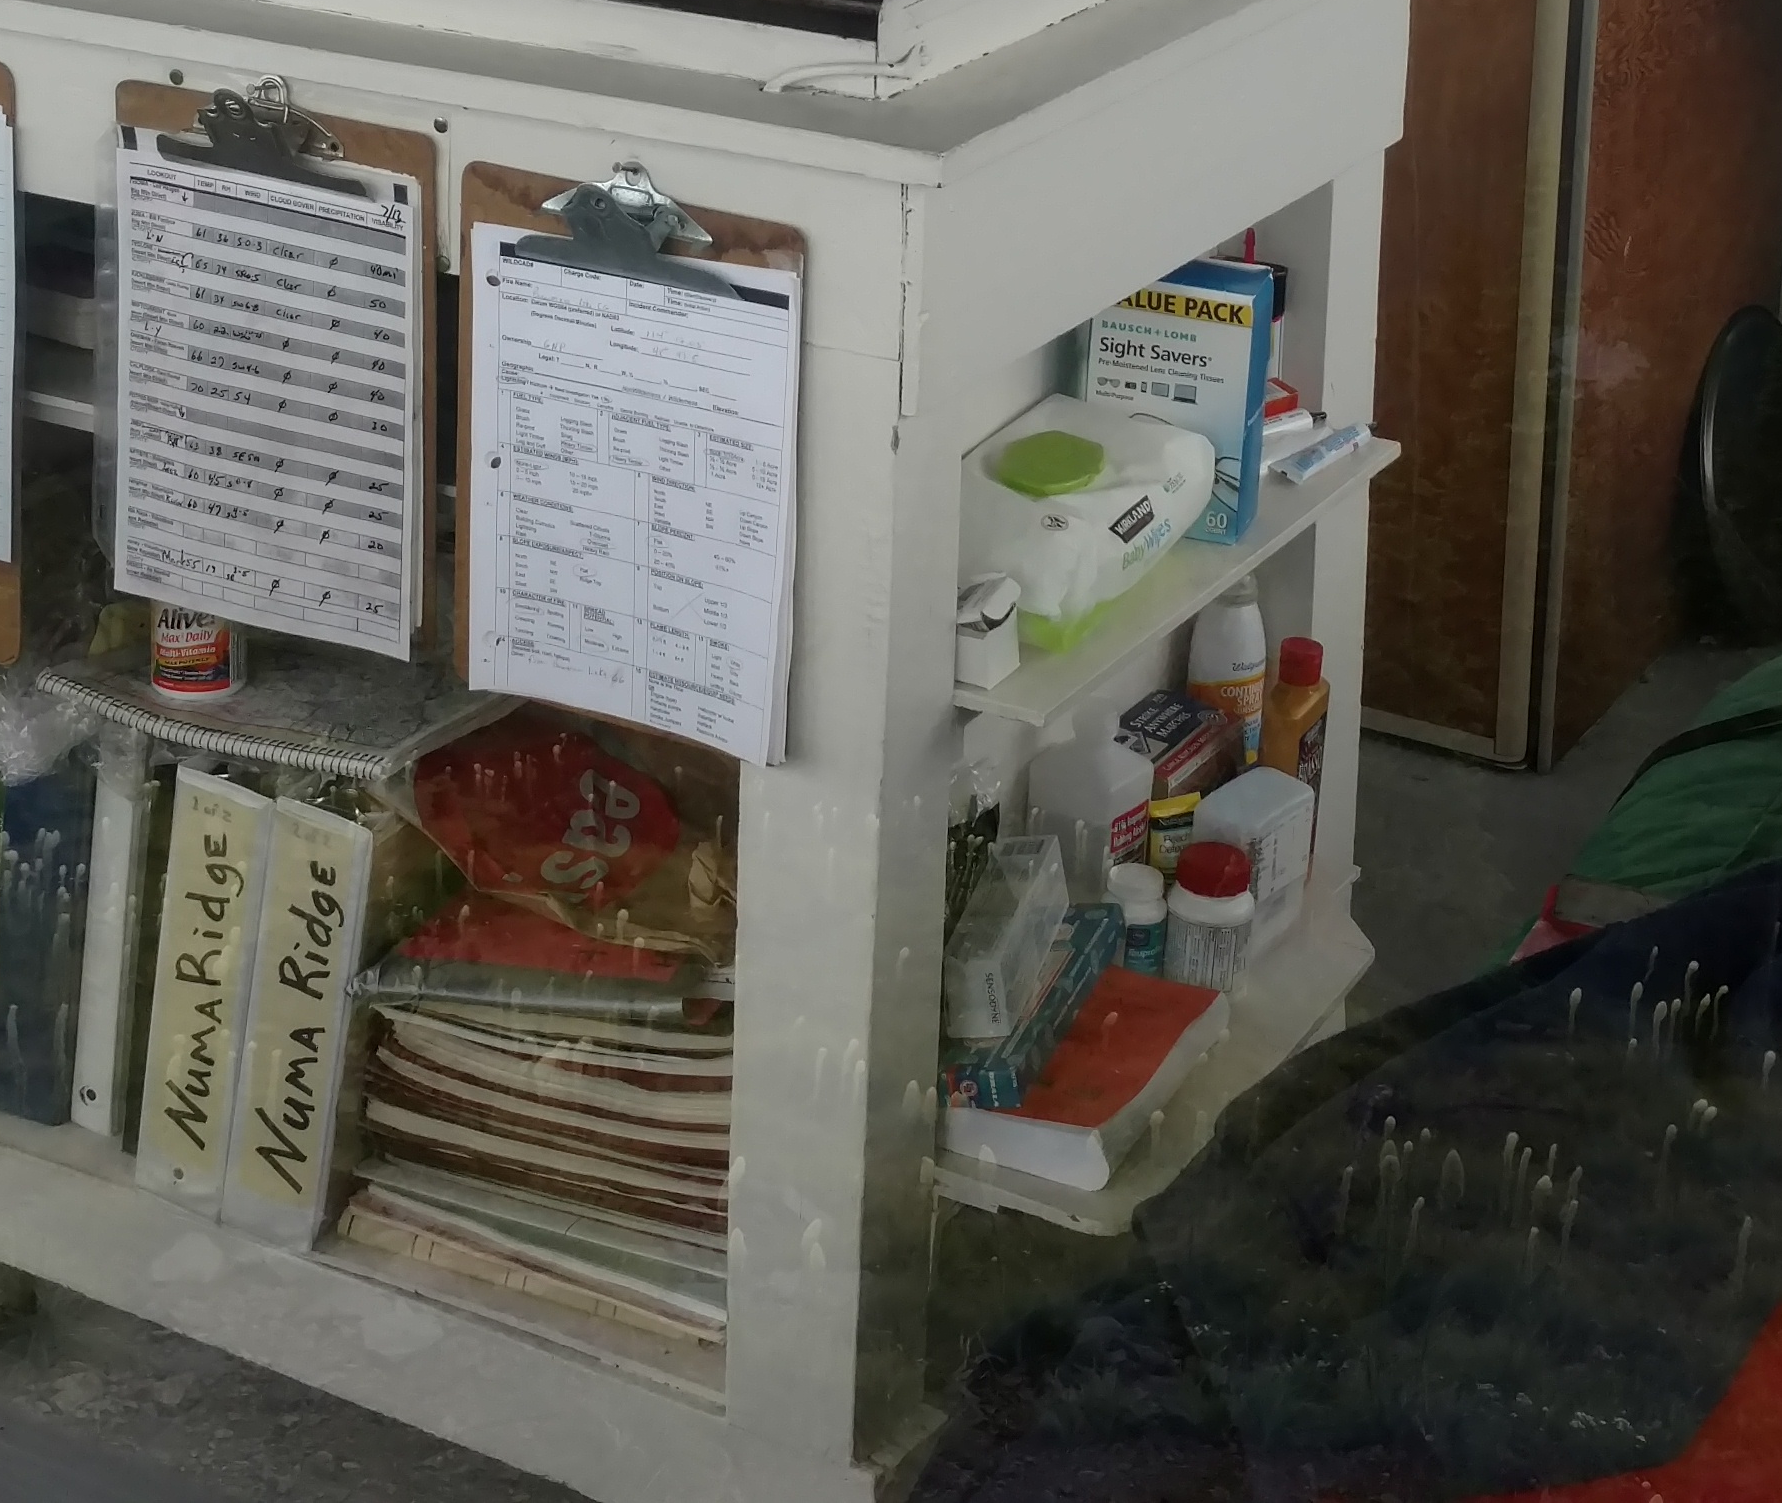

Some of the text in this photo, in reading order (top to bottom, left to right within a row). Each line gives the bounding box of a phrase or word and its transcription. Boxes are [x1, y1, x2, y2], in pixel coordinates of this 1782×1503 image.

[147, 169, 177, 181] LOOKOUT
[197, 180, 214, 188] TEMP
[244, 190, 261, 199] WIND
[270, 196, 292, 206] CLOUD
[293, 200, 315, 212] COVER
[318, 203, 366, 222] PRECIPITATION
[1116, 290, 1246, 326] ALUE PACK
[1101, 320, 1197, 343] BAUSCH LOMB
[1099, 336, 1146, 359] Sight
[1150, 364, 1167, 375] Lens
[210, 387, 230, 399] 25
[1205, 510, 1228, 530] 60
